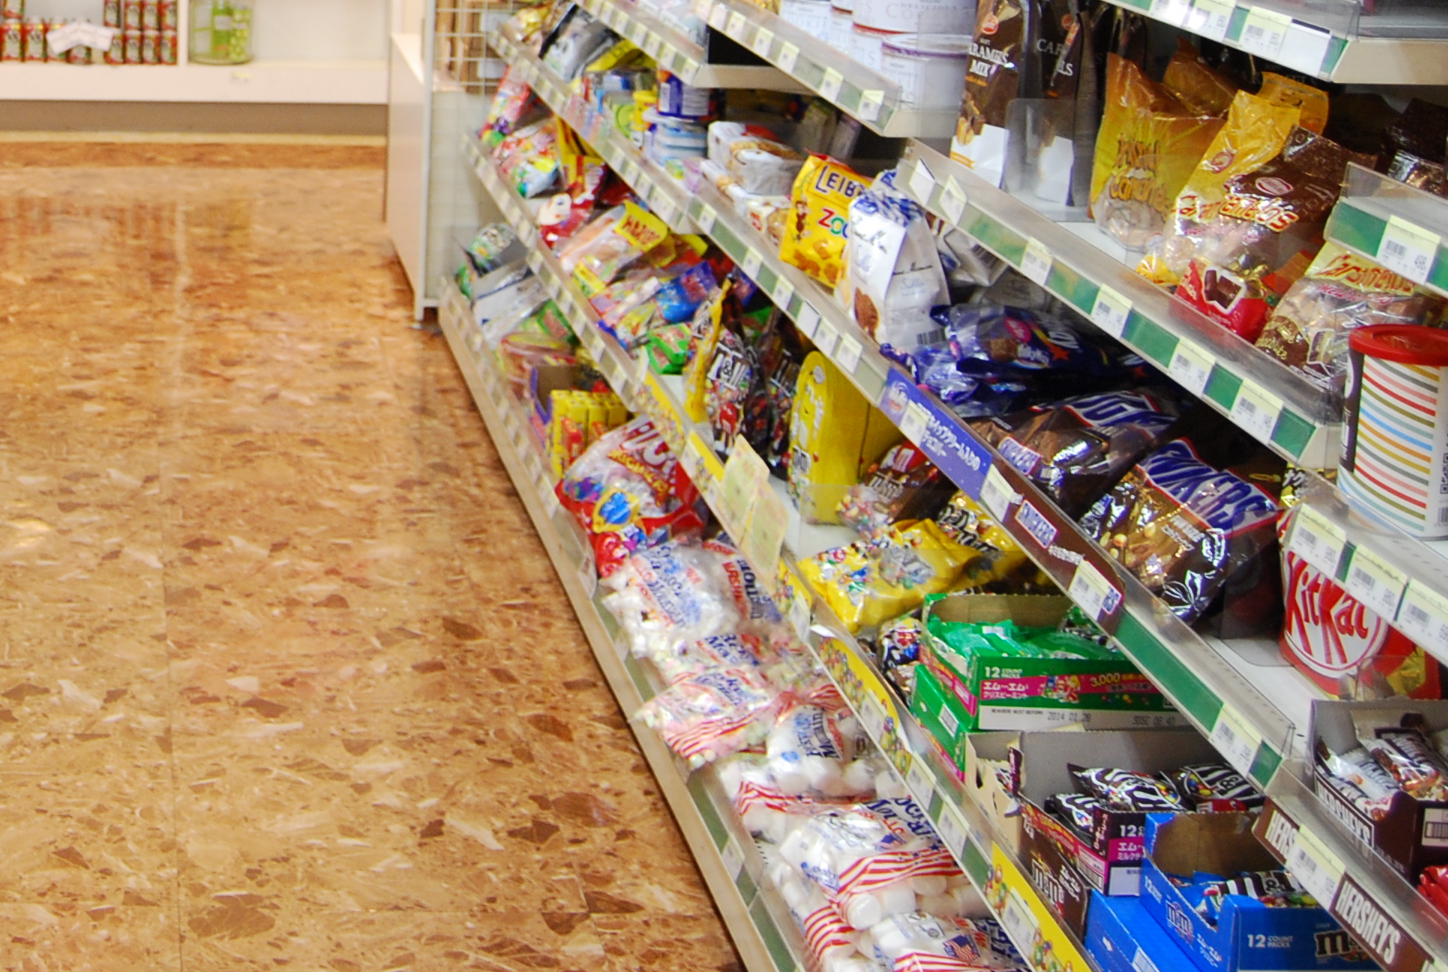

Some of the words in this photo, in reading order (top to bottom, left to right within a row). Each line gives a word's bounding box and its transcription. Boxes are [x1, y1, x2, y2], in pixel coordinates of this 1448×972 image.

[984, 666, 1001, 679] 12
[1090, 673, 1122, 688] 3,000
[1120, 824, 1138, 837] 12
[1265, 809, 1298, 865] HERS
[1334, 879, 1402, 966] HERSHEY'S
[1247, 934, 1266, 949] 12
